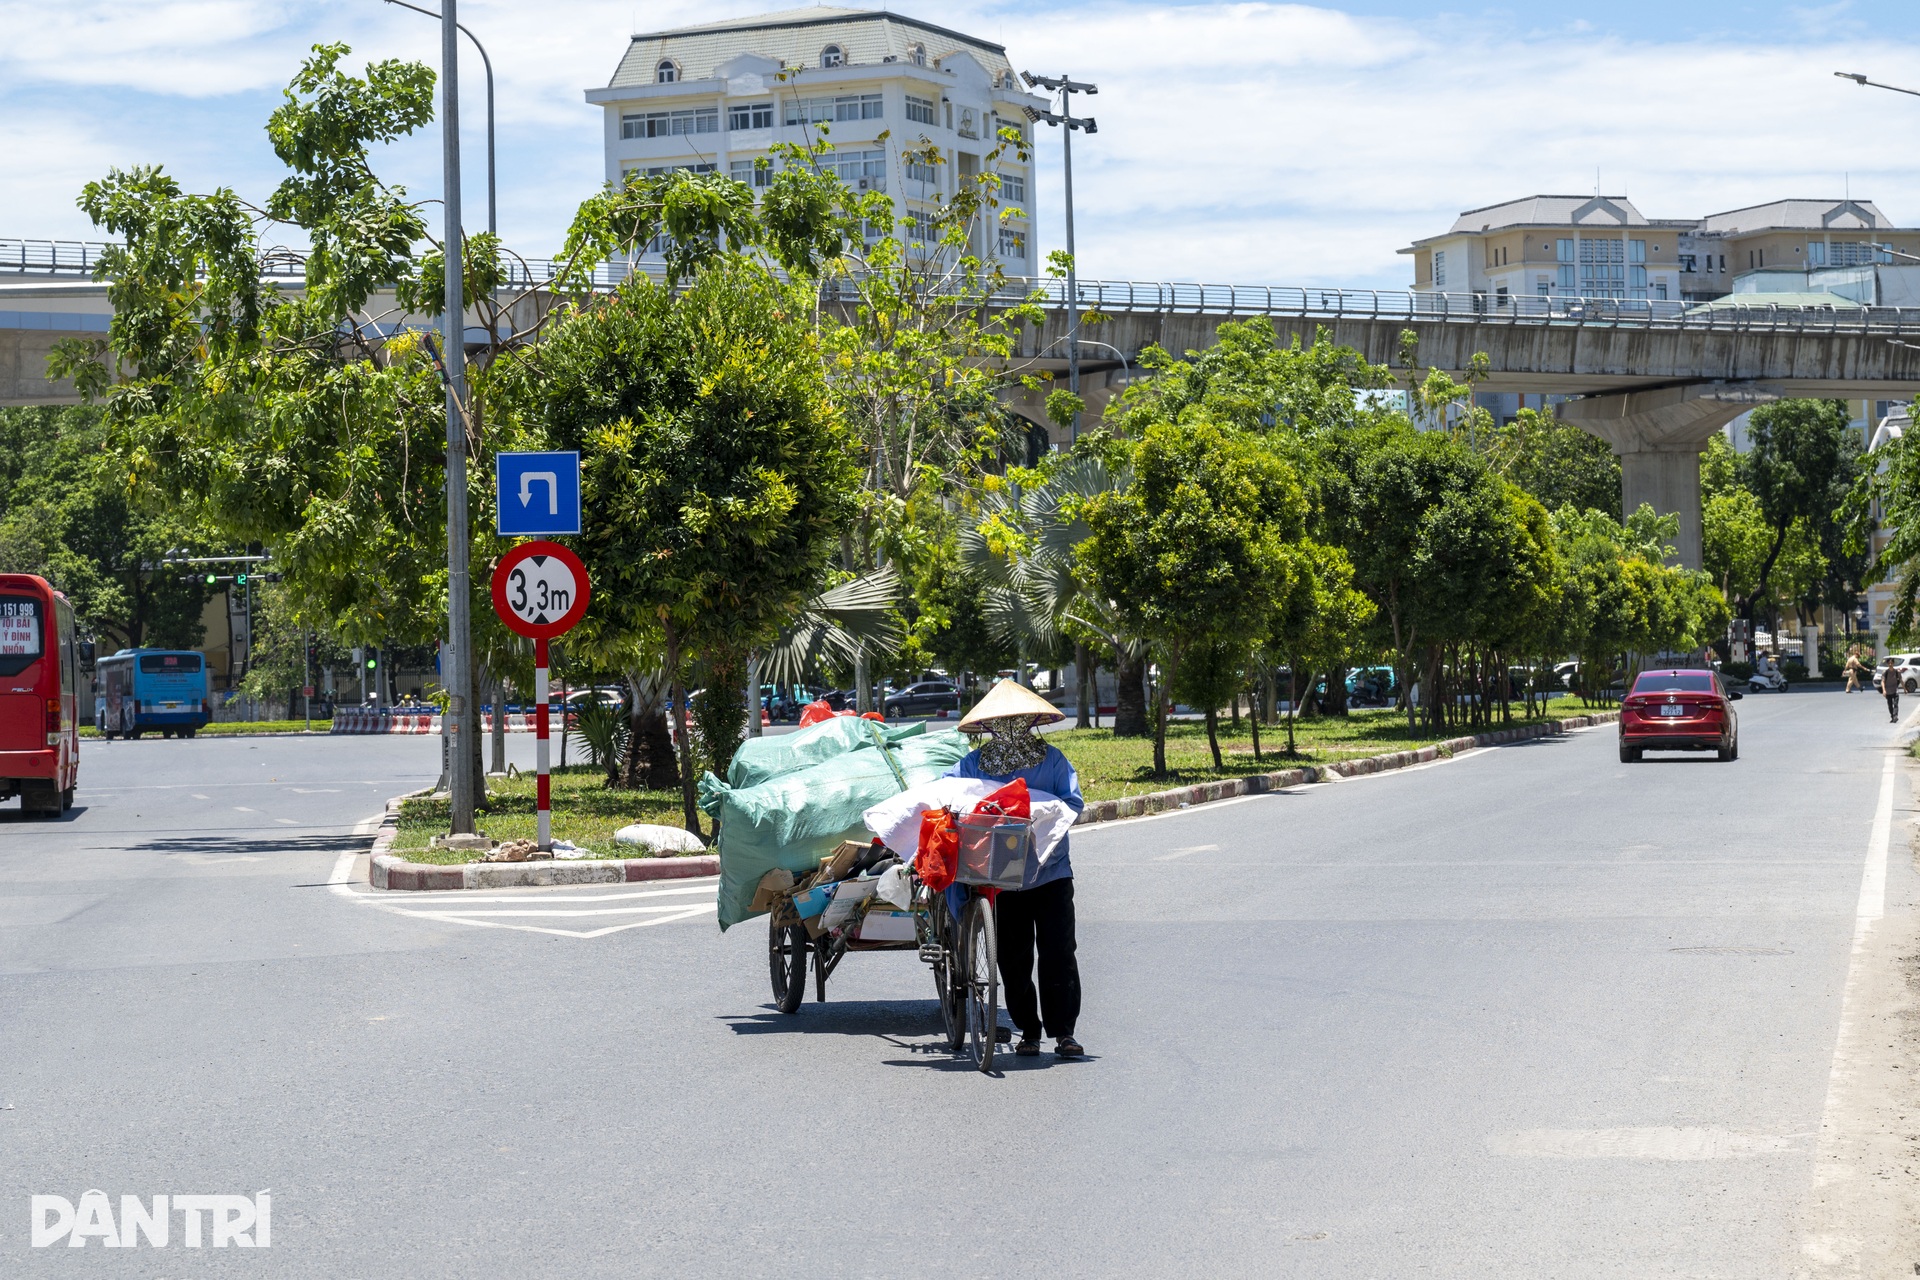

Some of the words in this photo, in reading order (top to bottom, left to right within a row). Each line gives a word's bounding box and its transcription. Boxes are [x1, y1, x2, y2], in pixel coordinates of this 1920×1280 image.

[237, 574, 246, 584] 12
[510, 568, 570, 617] 3,3m
[3, 603, 17, 616] 151
[19, 603, 34, 616] 998
